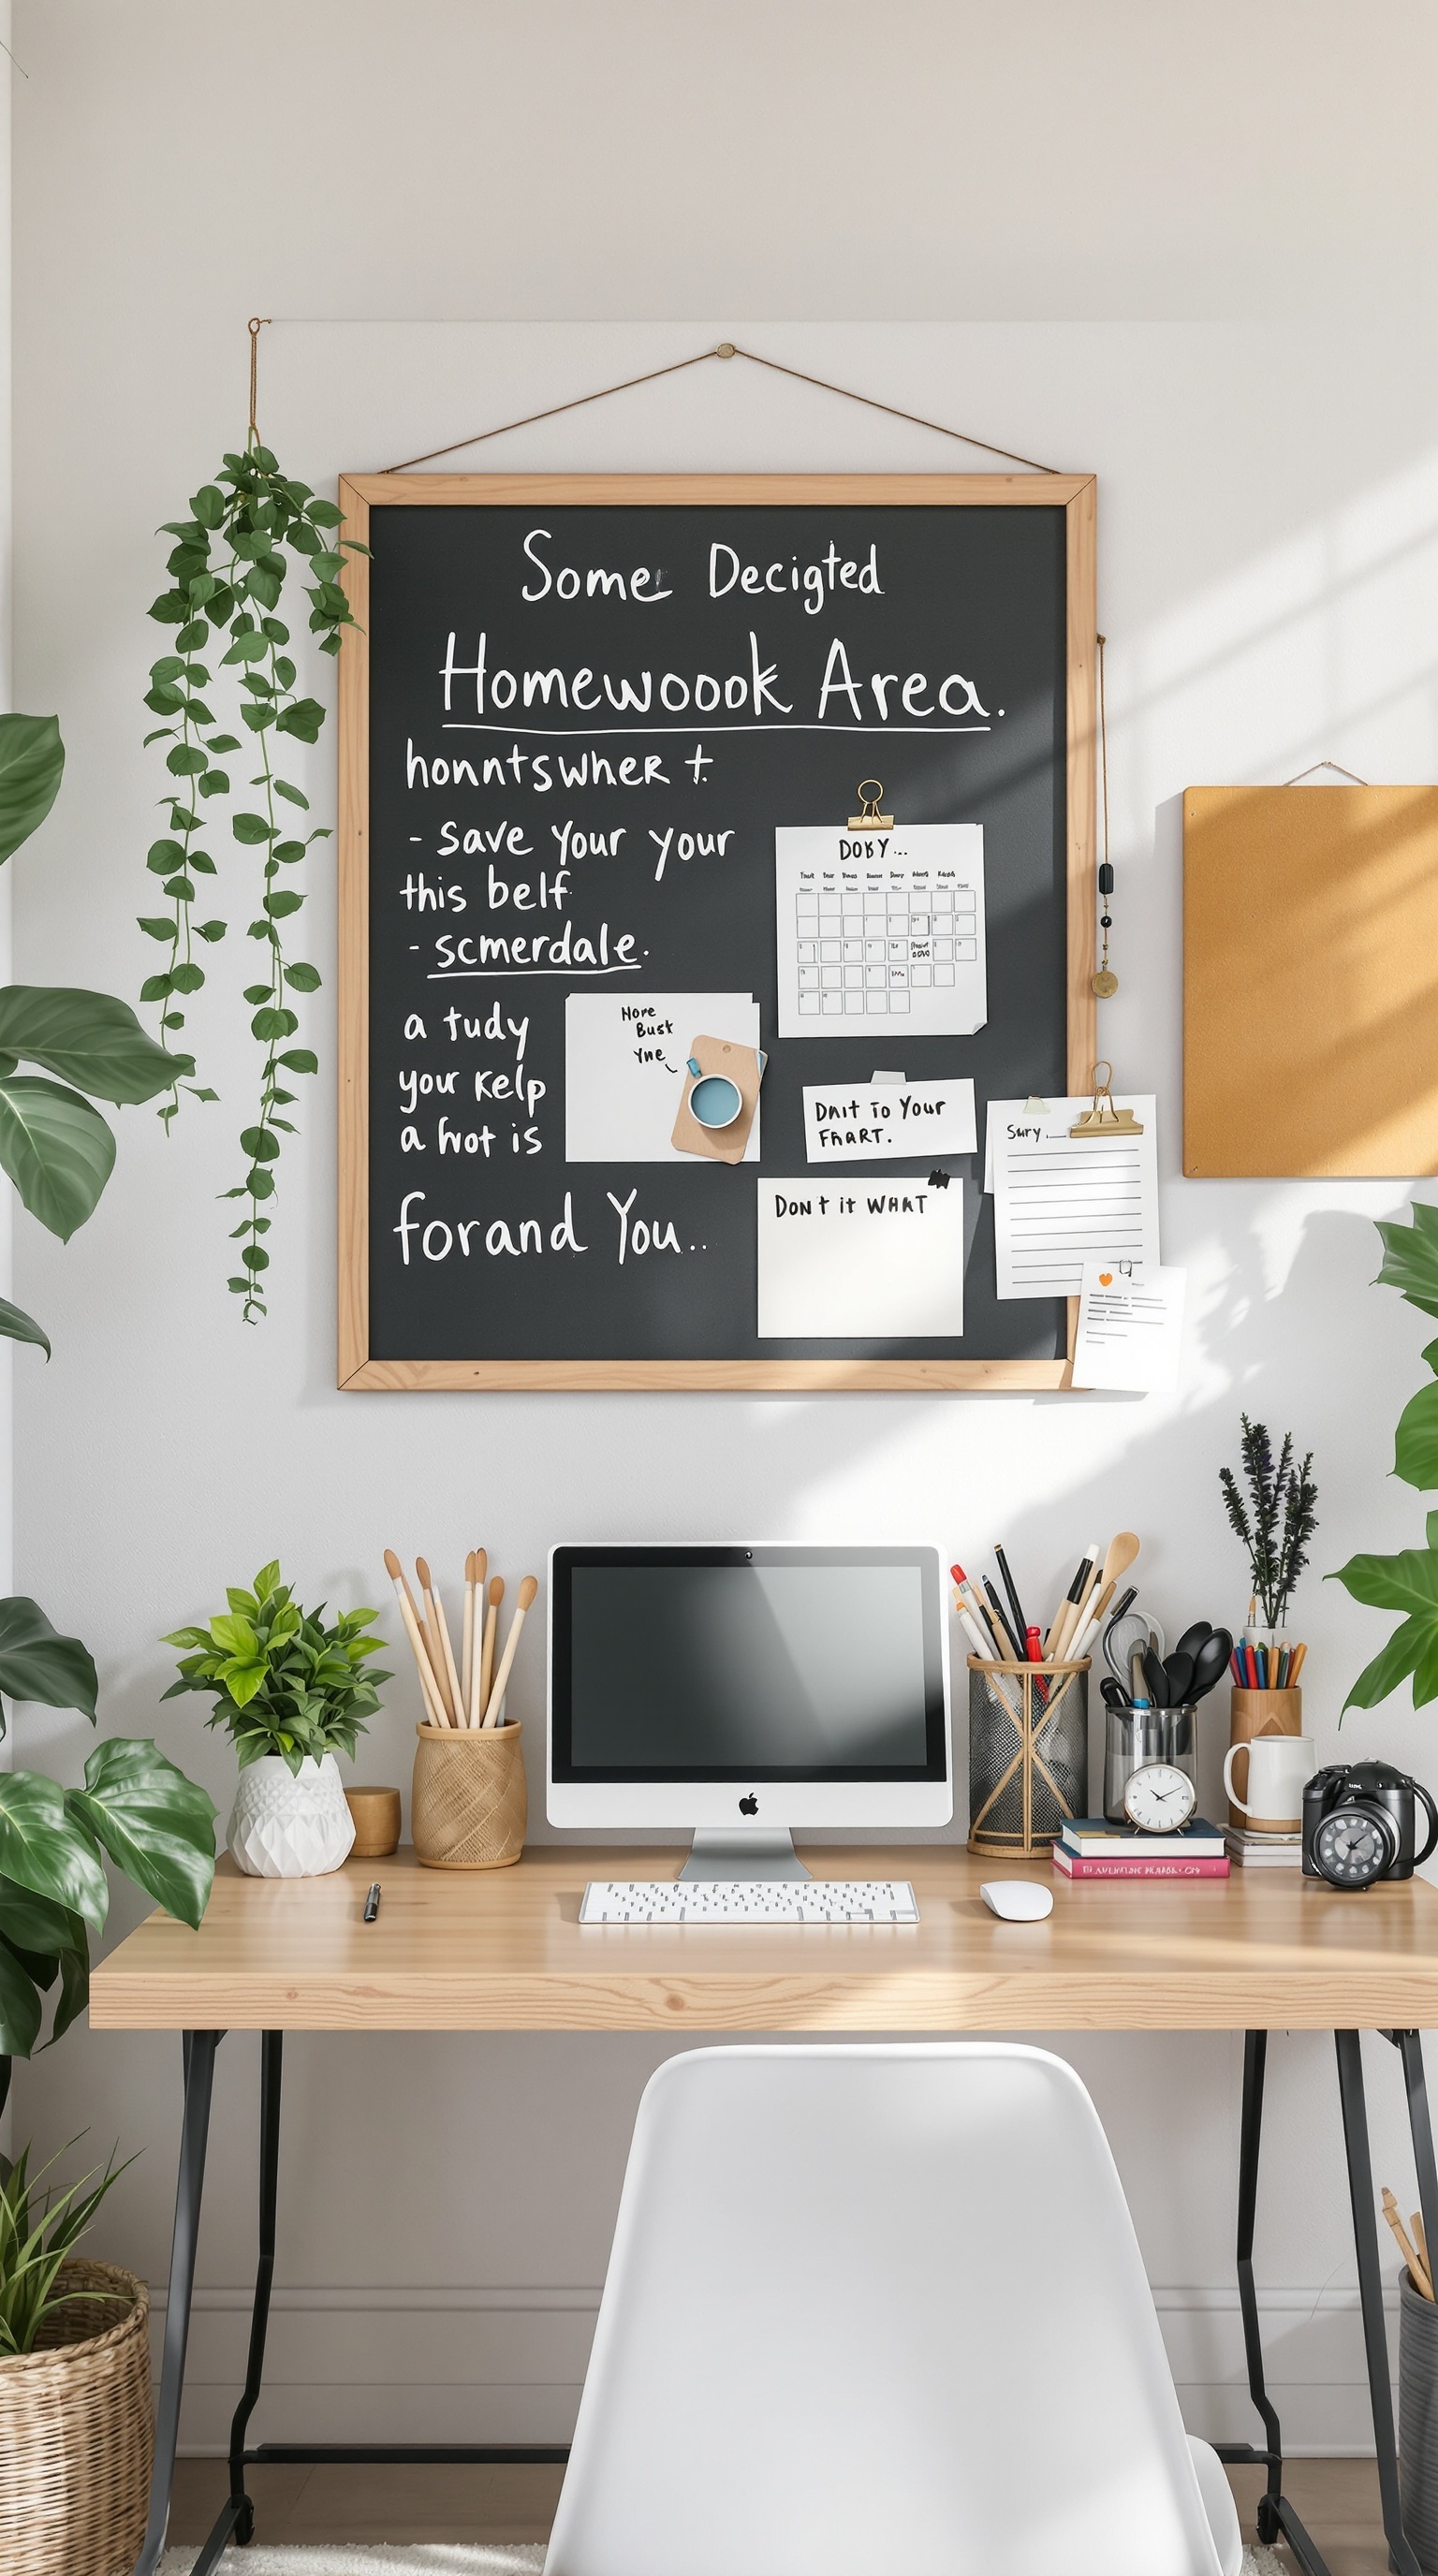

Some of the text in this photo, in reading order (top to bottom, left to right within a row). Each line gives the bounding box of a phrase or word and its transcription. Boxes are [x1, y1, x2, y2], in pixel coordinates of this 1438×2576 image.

[521, 529, 886, 615] Some Decigted
[817, 638, 1005, 722] Area.
[436, 821, 534, 856] save
[399, 871, 467, 913] this
[404, 1013, 428, 1041] a
[400, 1125, 427, 1153] a
[511, 1122, 543, 1155] is
